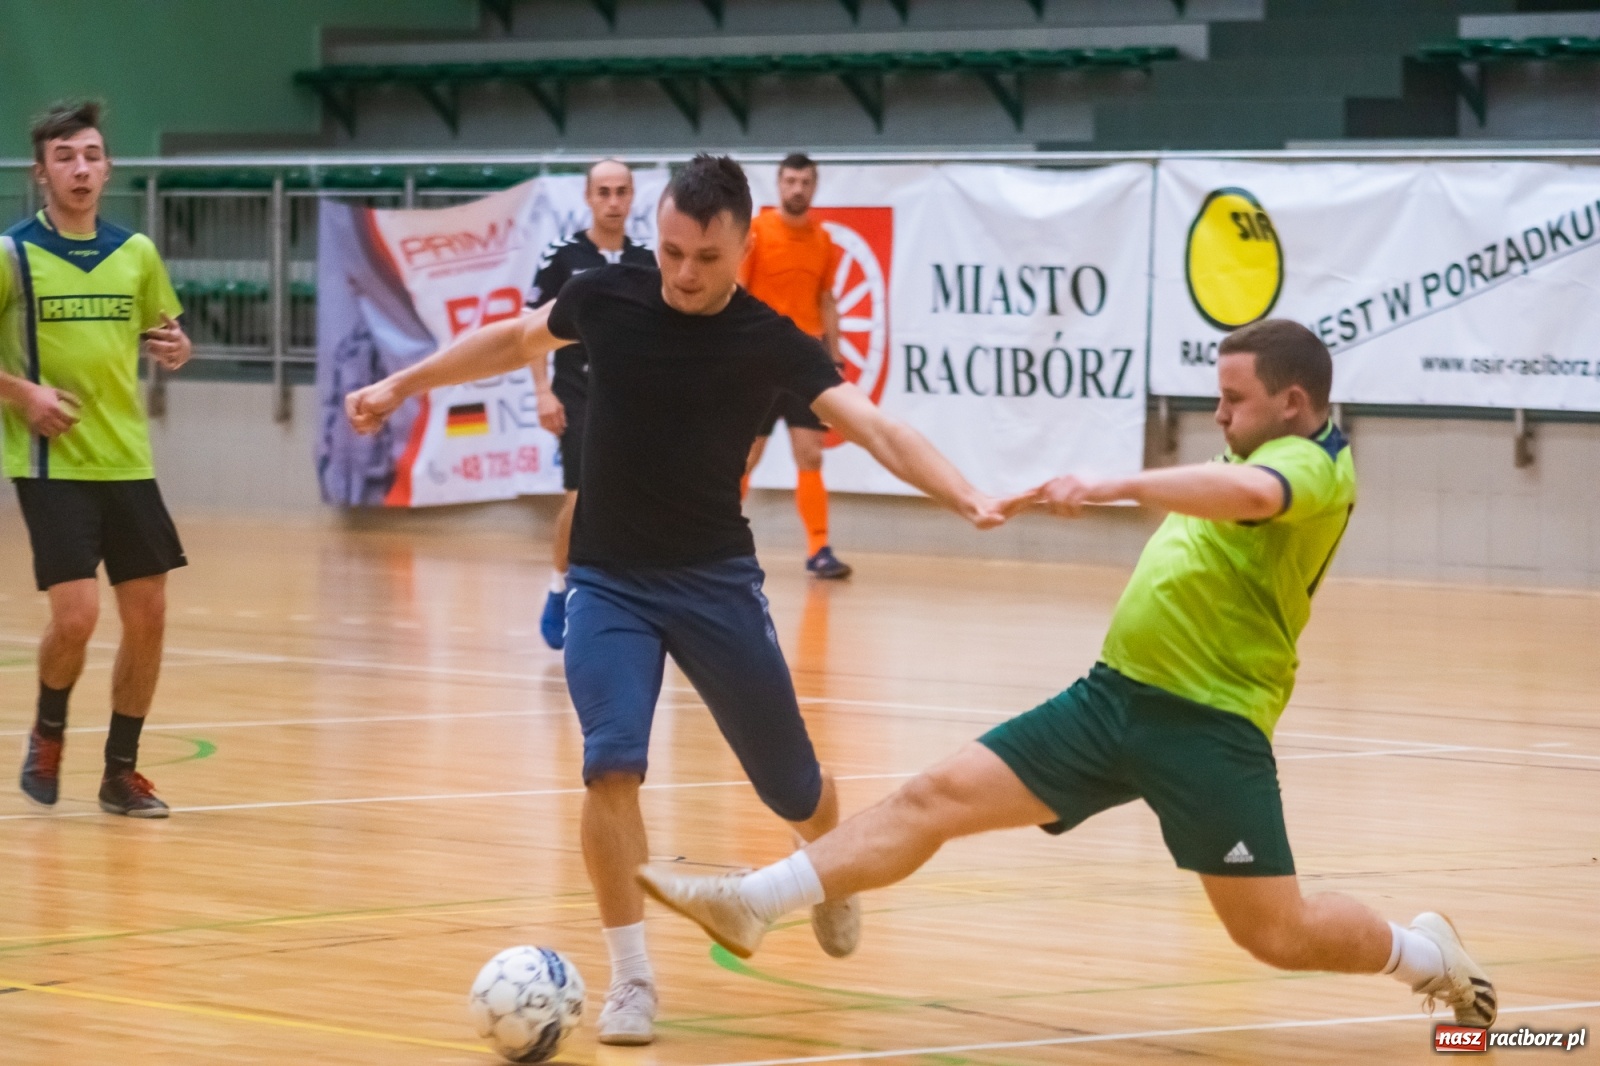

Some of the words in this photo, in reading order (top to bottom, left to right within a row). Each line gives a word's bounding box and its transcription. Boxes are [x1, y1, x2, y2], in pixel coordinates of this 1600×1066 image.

[930, 263, 1108, 318] MIASTO
[1309, 298, 1373, 348] EST
[1382, 282, 1411, 322] W
[1422, 199, 1600, 307] PORZĄDKU
[902, 330, 1136, 400] RACIBÓRZ
[1181, 340, 1218, 366] RAC
[1421, 353, 1600, 379] www.osir-raciborz.
